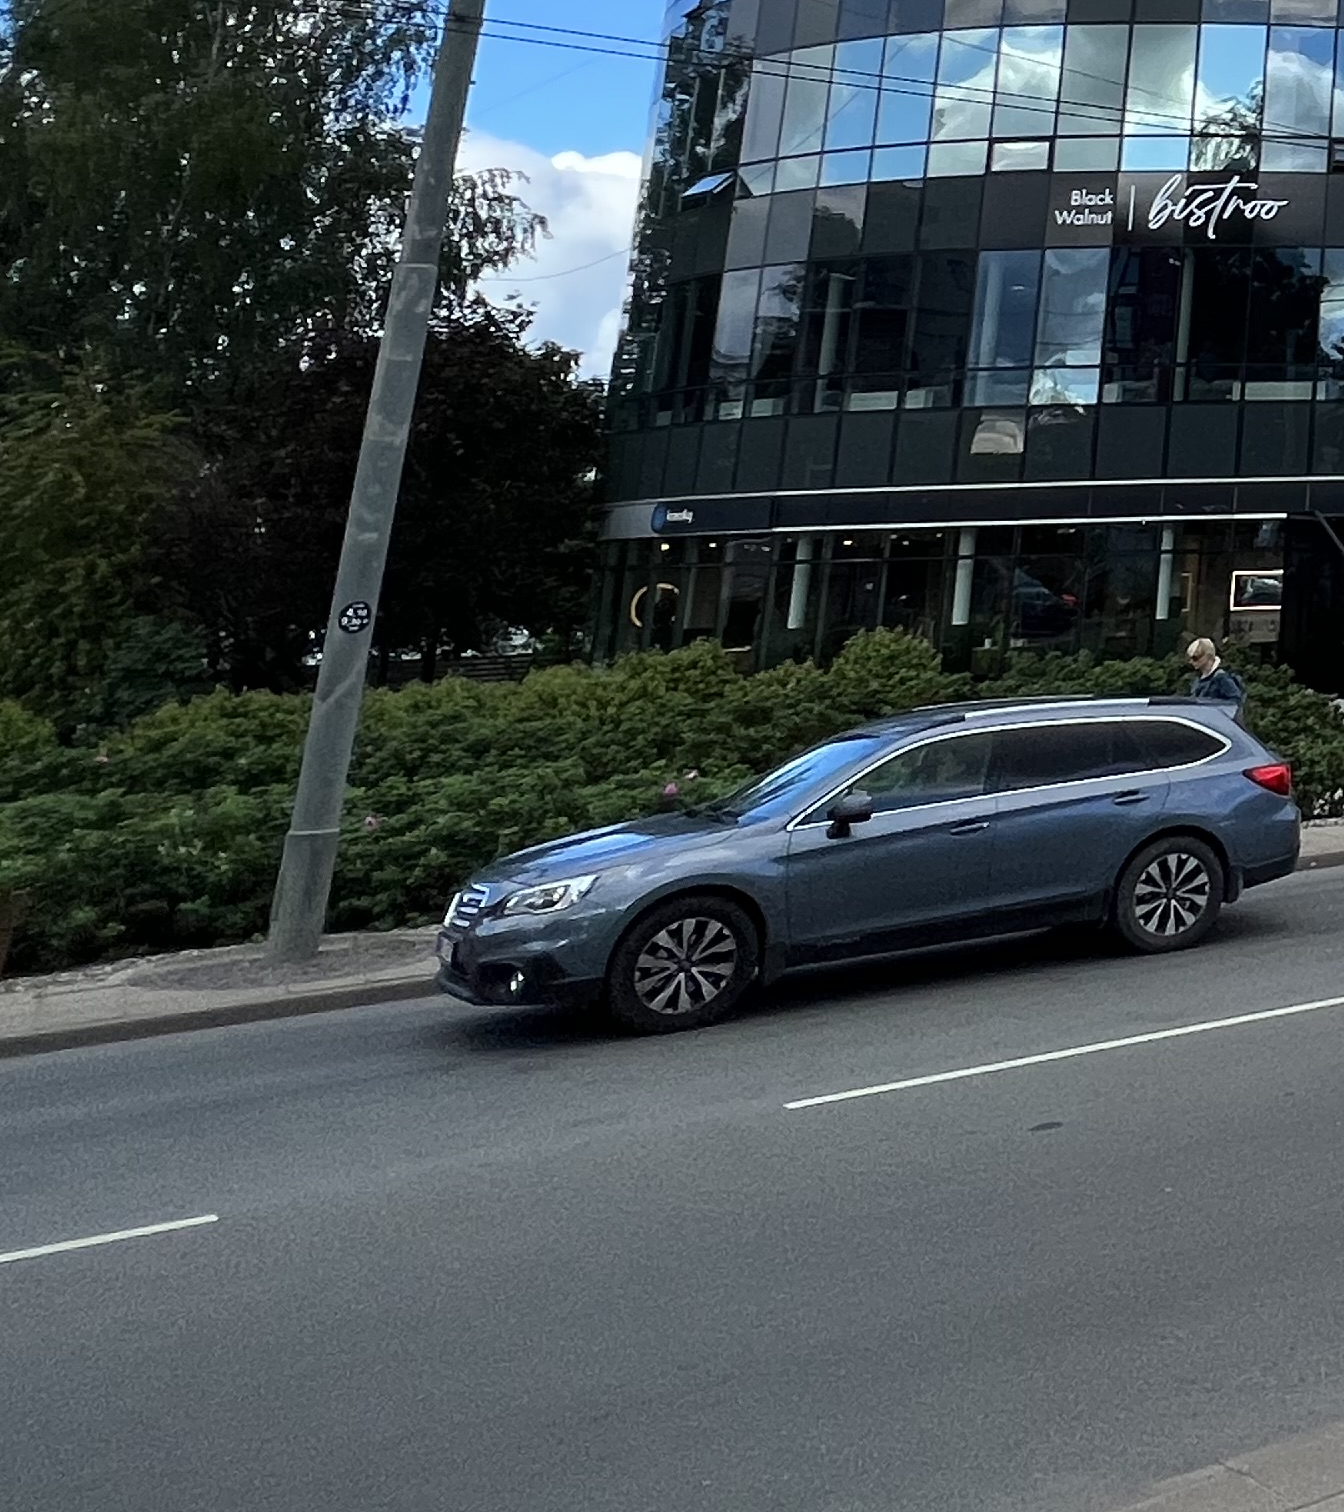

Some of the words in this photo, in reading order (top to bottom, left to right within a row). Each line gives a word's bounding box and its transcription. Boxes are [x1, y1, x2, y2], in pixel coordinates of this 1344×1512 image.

[1070, 188, 1114, 207] Black
[1148, 173, 1289, 239] bistroo
[1054, 208, 1113, 226] Walnut
